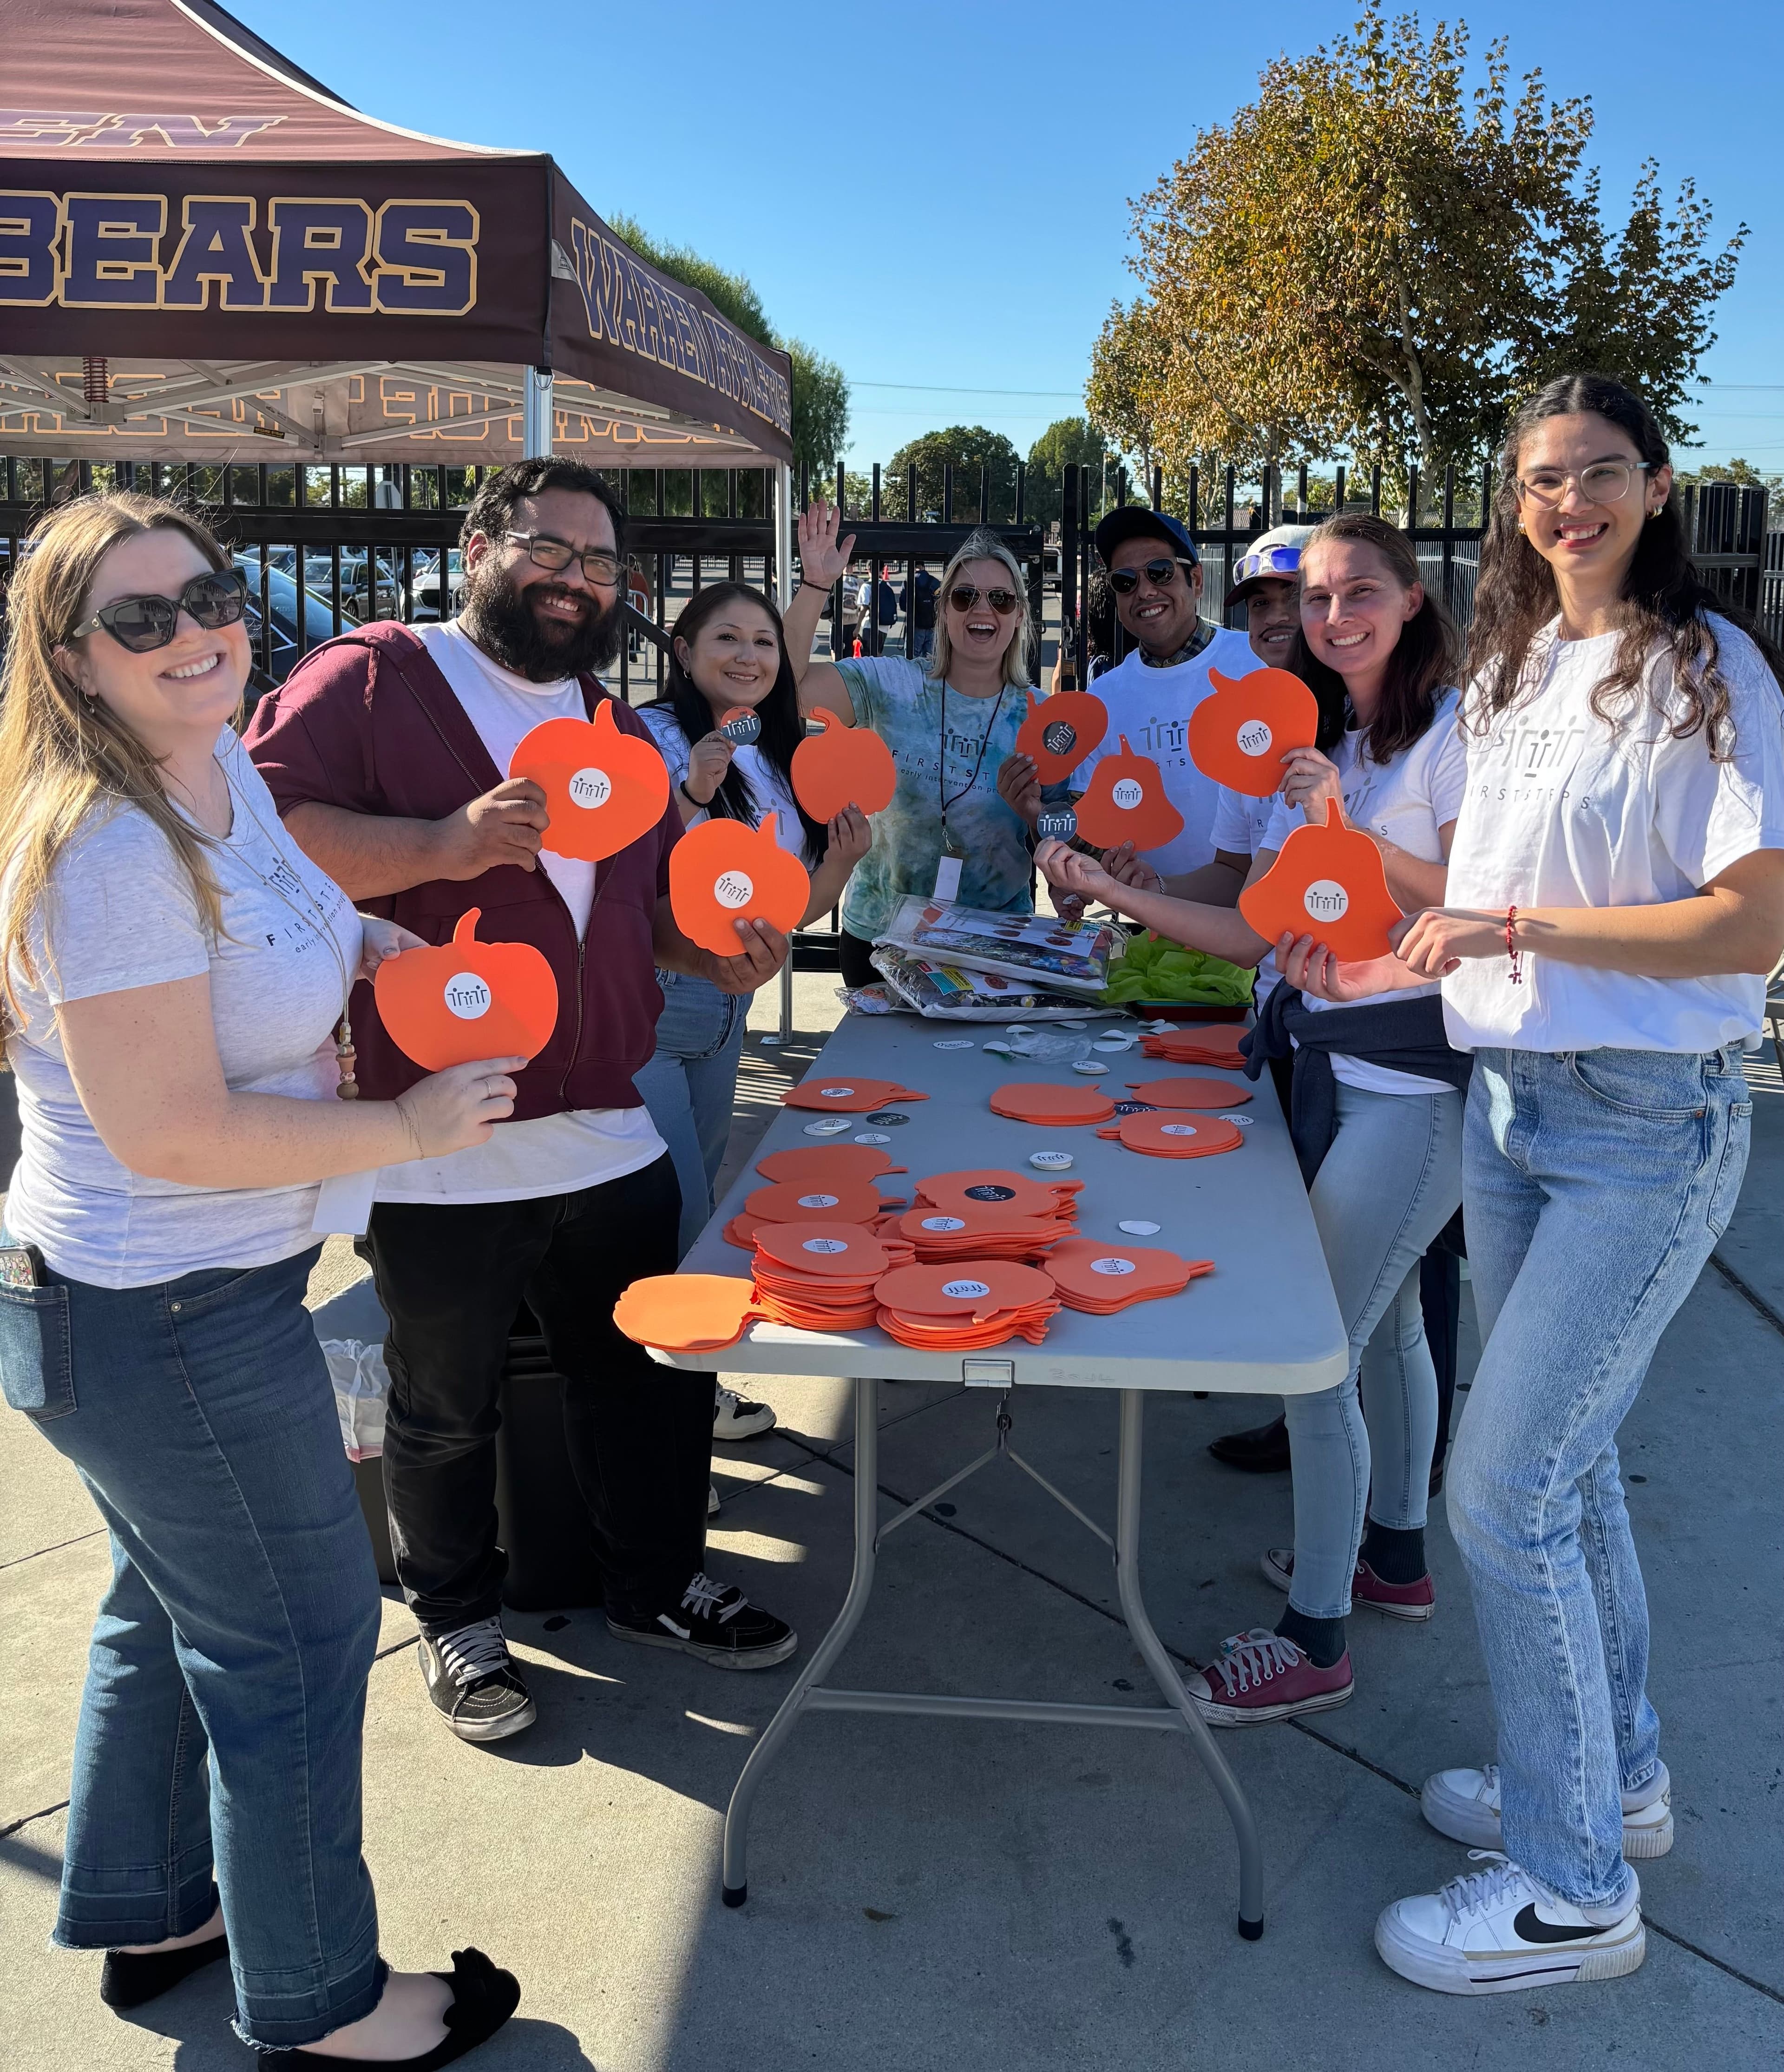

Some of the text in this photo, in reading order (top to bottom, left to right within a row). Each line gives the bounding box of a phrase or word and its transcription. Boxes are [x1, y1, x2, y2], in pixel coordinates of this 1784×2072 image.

[571, 217, 715, 389] WARREN
[901, 769, 922, 779] early
[295, 938, 316, 953] early
